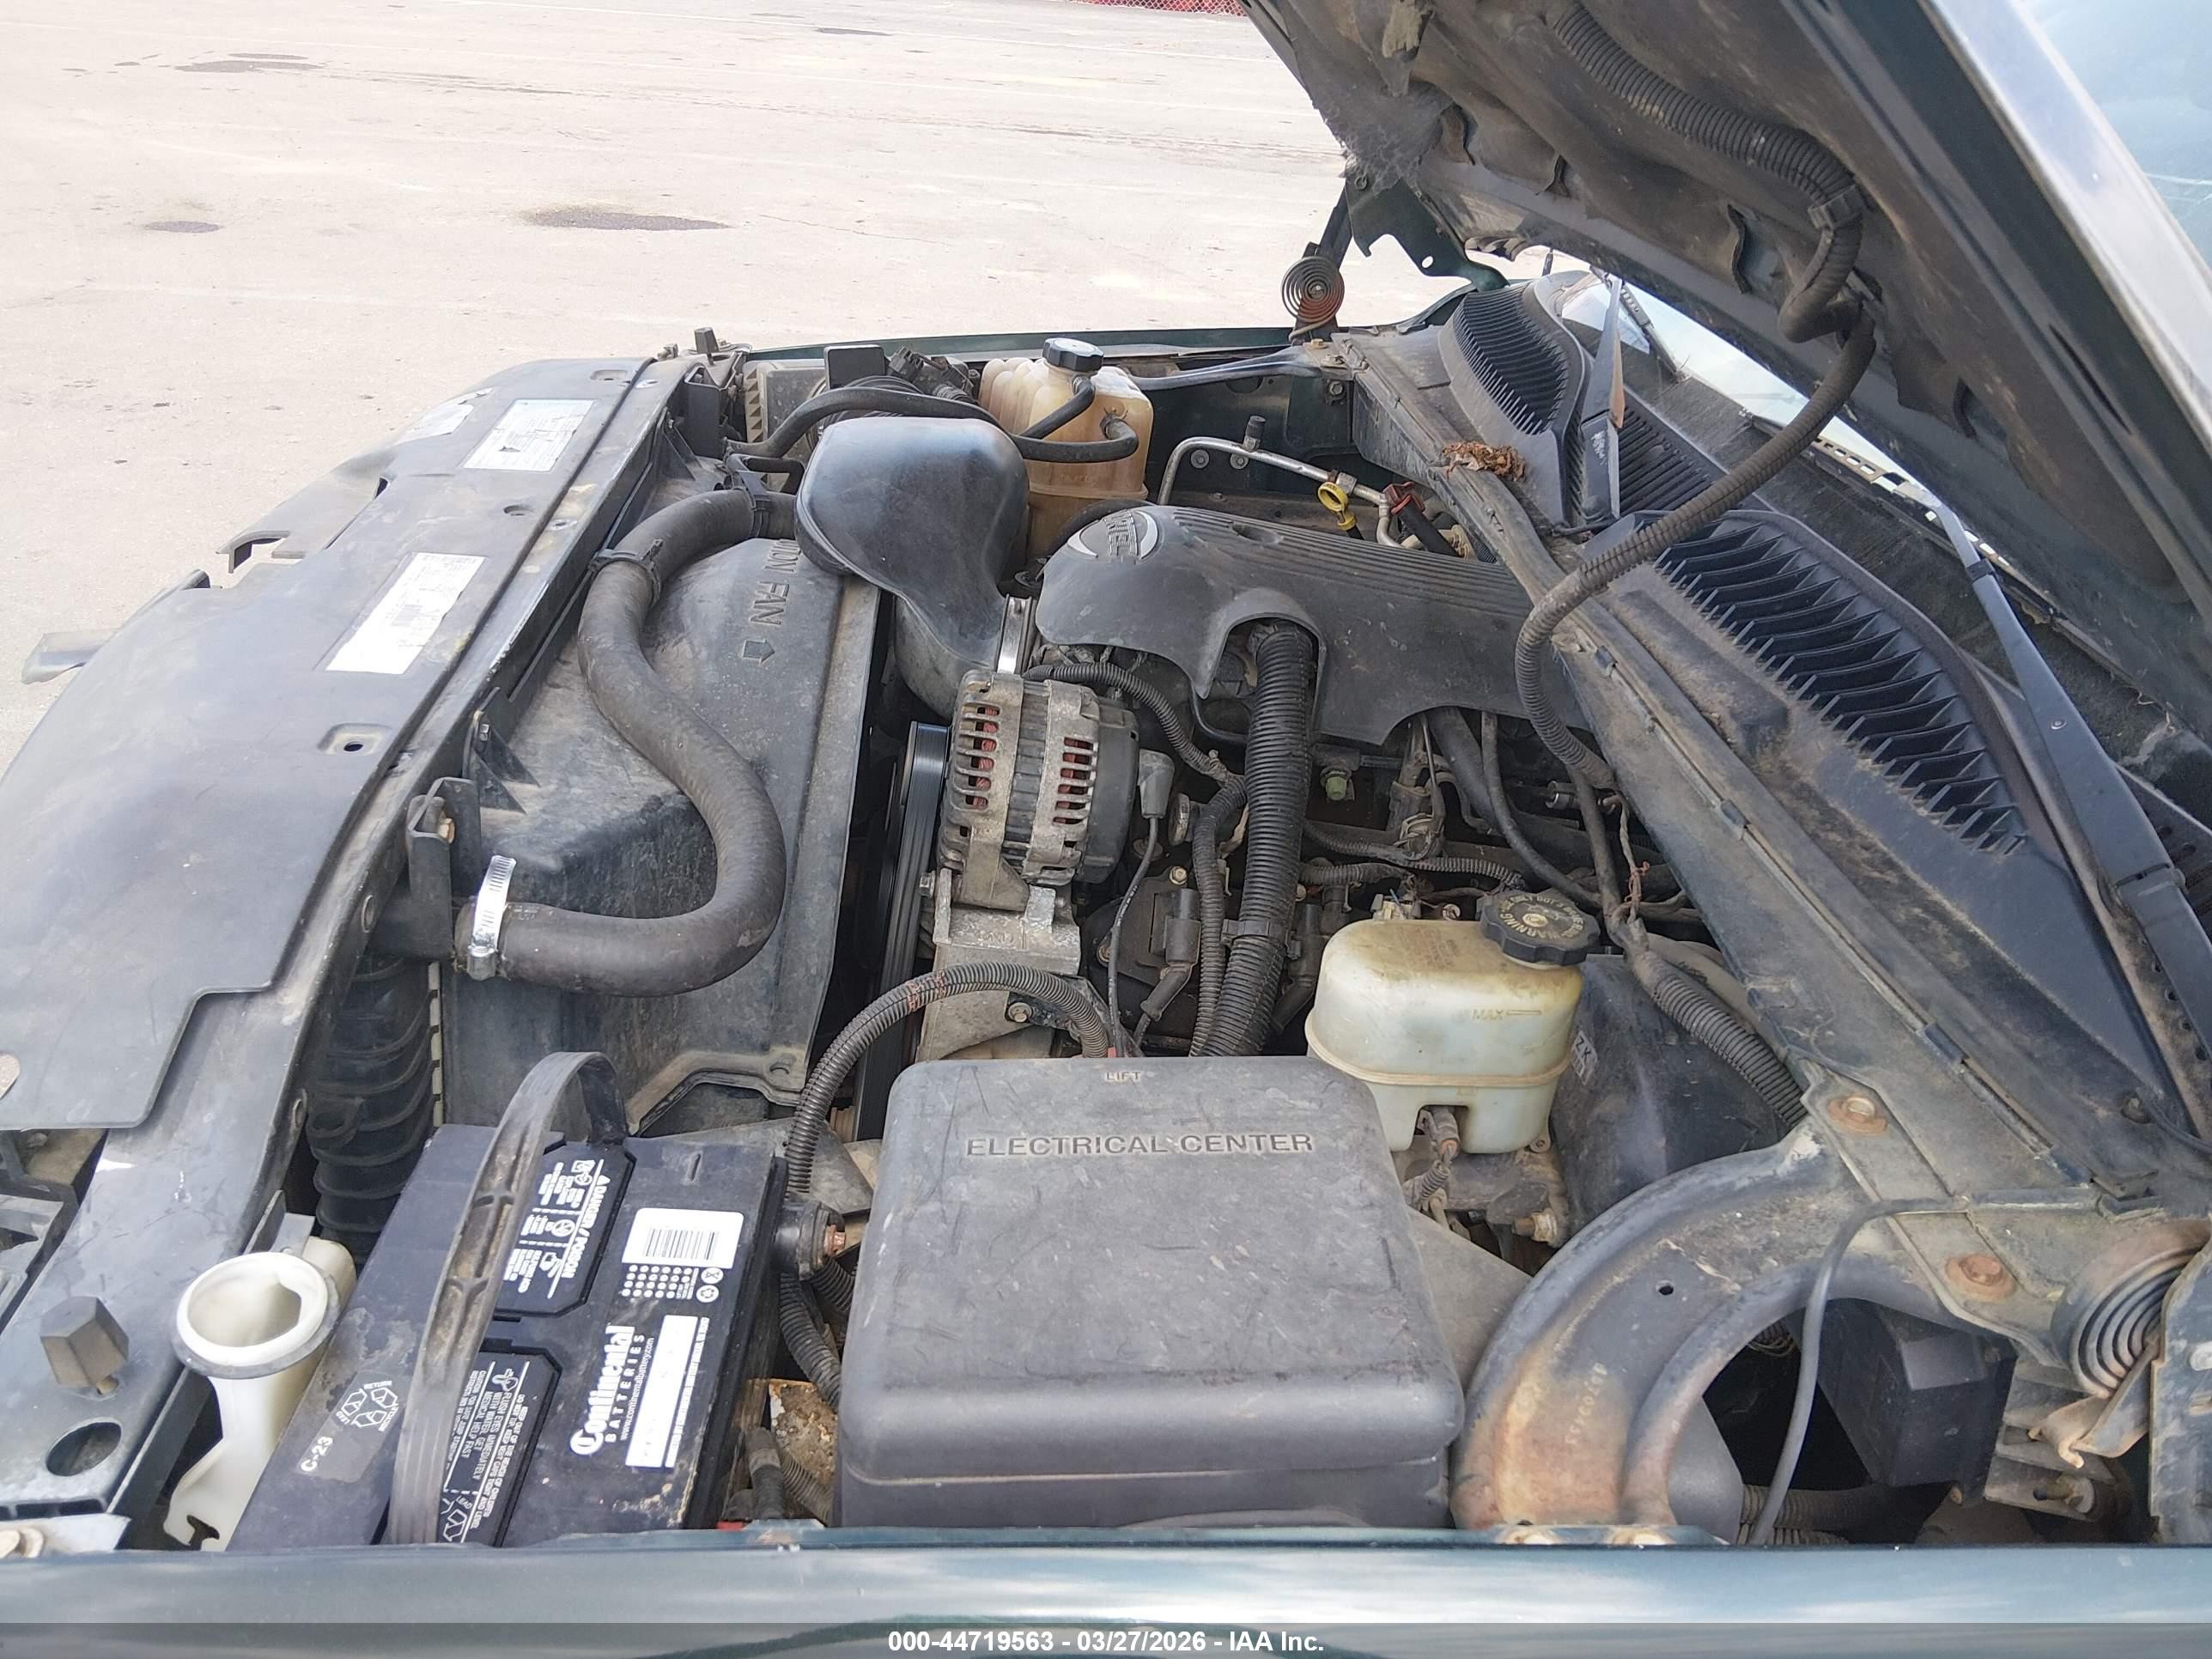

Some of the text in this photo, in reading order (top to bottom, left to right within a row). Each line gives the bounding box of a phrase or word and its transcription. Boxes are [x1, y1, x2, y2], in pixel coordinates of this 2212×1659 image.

[749, 580, 791, 626] FAN
[1471, 1009, 1504, 1022] MAX
[1105, 1070, 1141, 1081] LIFT
[966, 1133, 1315, 1158] ELECTRICAL CENTER
[580, 1185, 608, 1229] DANGER
[562, 1237, 589, 1279] POISON
[489, 1392, 503, 1410] WITH
[569, 1325, 636, 1455] Continental
[604, 1334, 645, 1443] BATTERIES
[619, 1336, 654, 1442] www.continentalbattery.com
[474, 1391, 493, 1420] MEDICAL
[468, 1421, 482, 1440] HELP
[471, 1392, 513, 1480] FLUSH EYES IMMEDIATELY
[472, 1437, 486, 1451] GET
[301, 1436, 333, 1473] C-23
[460, 1440, 476, 1459] FAST
